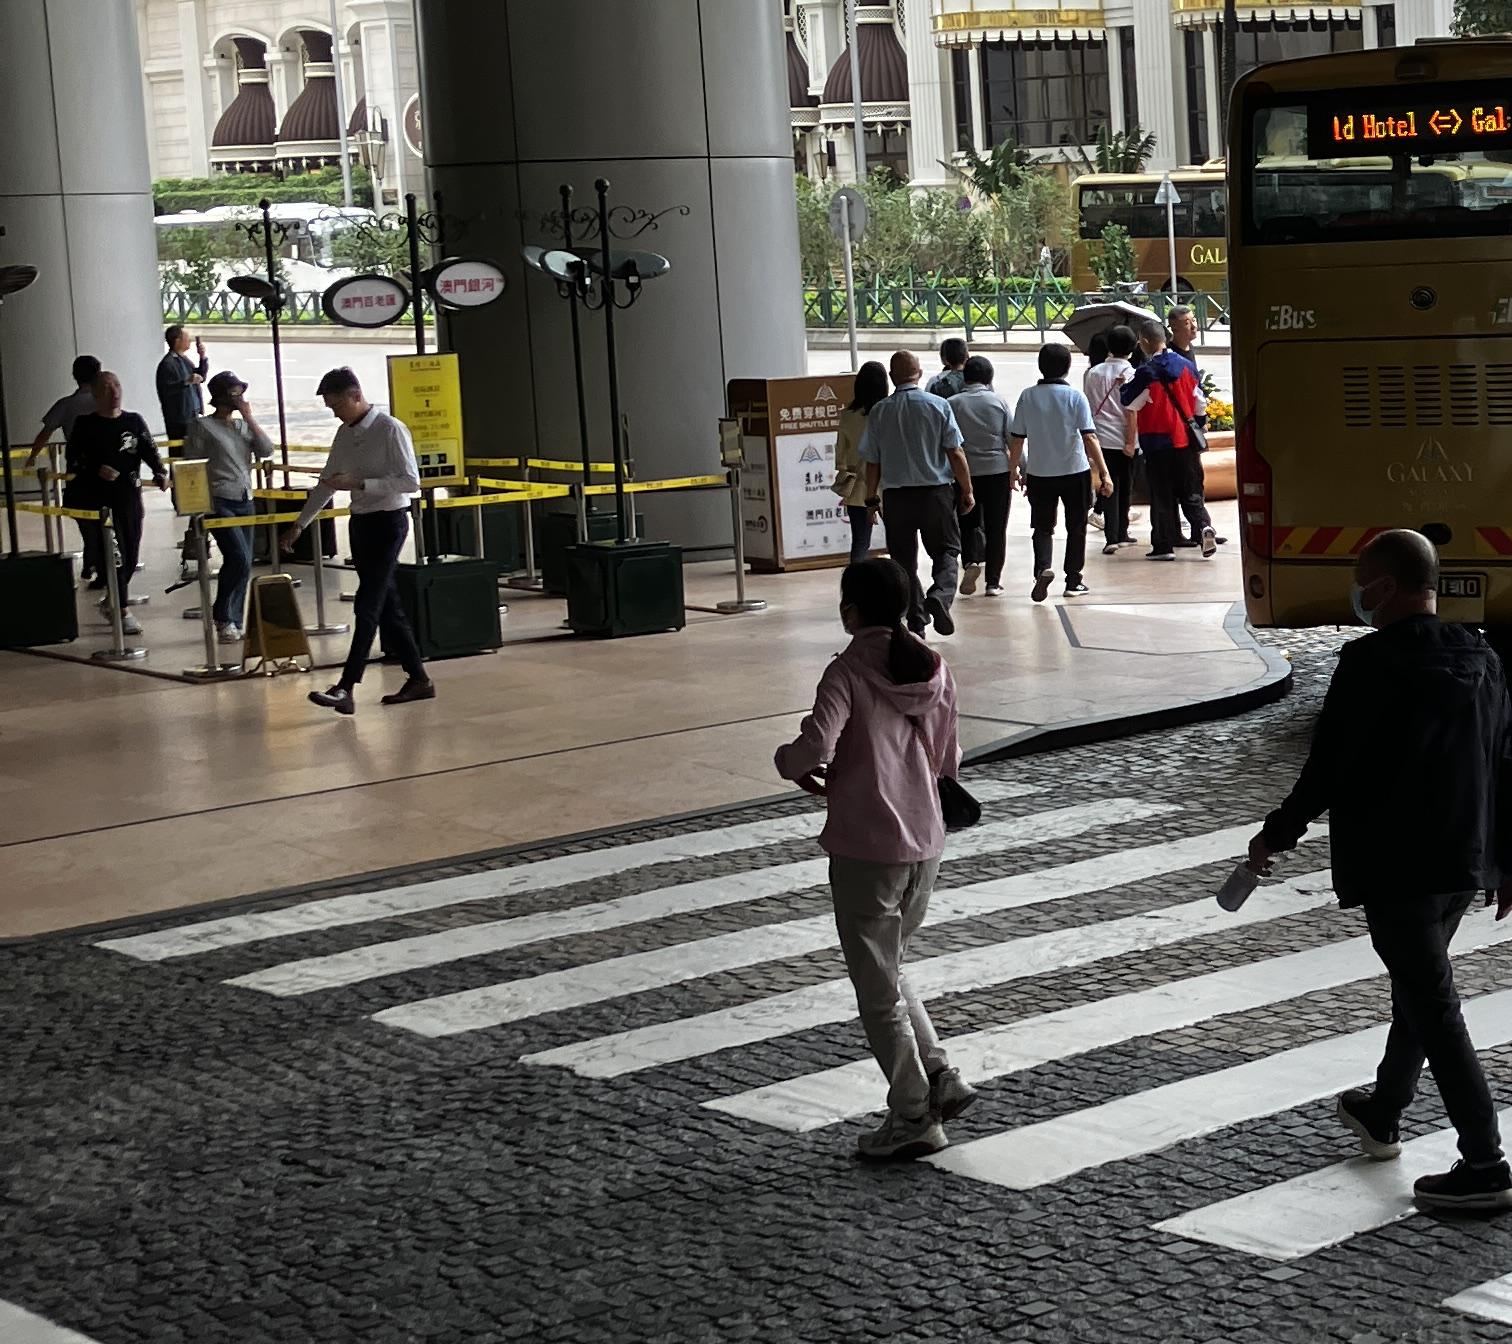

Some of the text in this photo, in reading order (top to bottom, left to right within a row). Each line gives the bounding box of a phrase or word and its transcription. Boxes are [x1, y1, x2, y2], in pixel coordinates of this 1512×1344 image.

[1361, 111, 1418, 139] Hotel
[1471, 106, 1511, 133] Gal
[1190, 244, 1228, 265] GAL
[780, 419, 841, 431] FREE SHUTTLE BU
[1387, 461, 1473, 483] GALAXY
